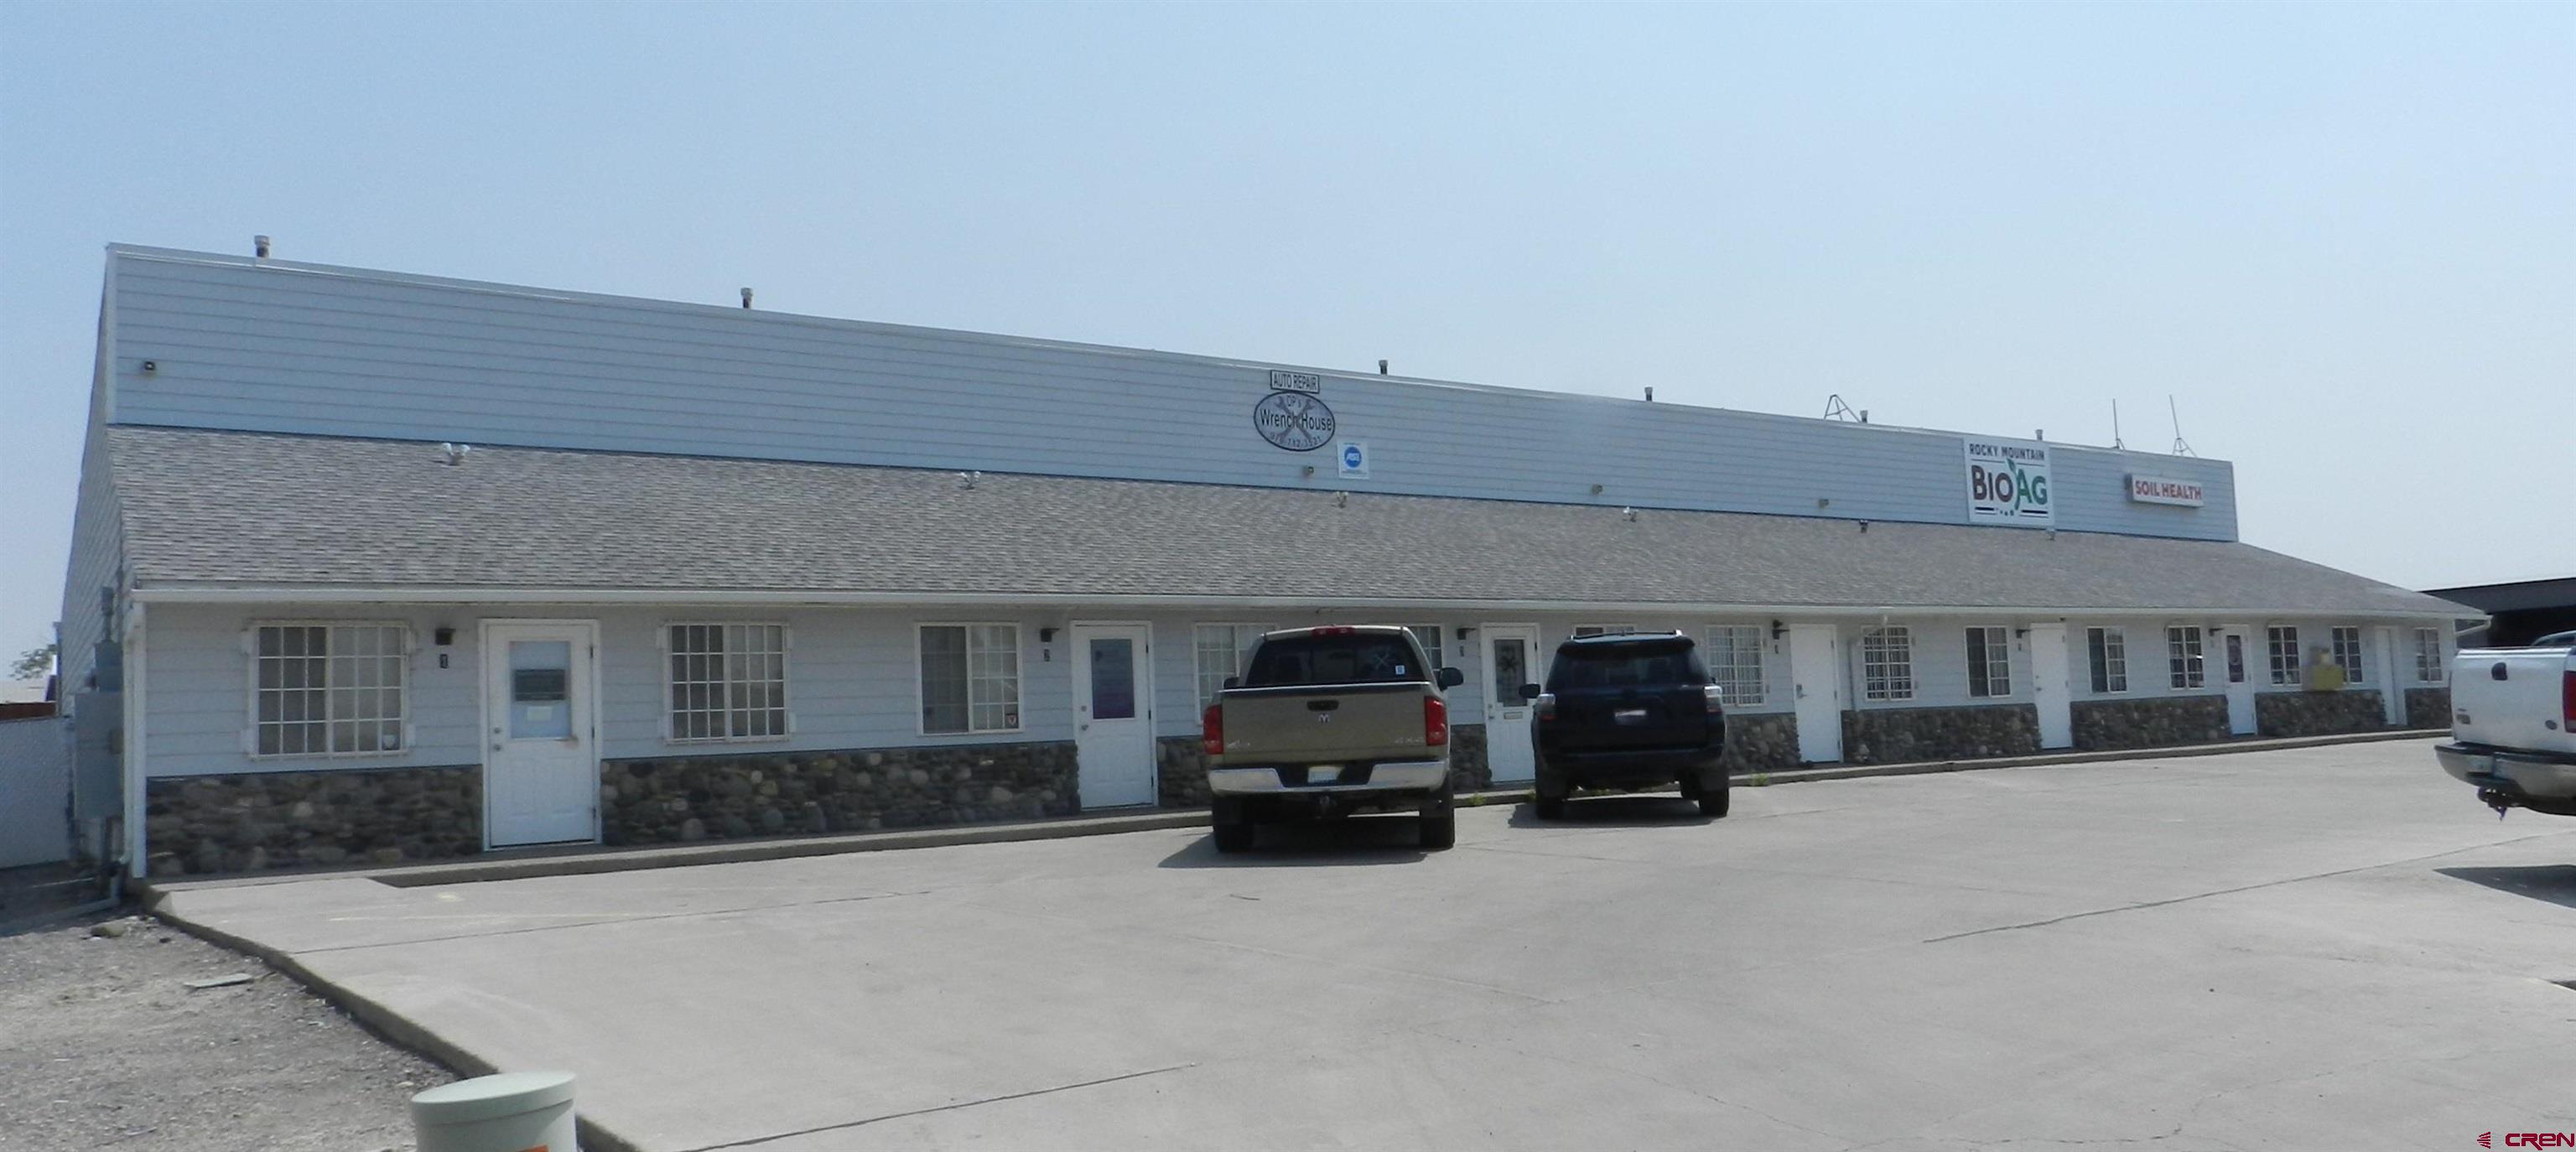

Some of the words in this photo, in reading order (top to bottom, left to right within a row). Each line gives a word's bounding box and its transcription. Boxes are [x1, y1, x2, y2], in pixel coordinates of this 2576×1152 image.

[1274, 373, 1292, 387] AUTO
[1294, 375, 1317, 390] REPAIR
[1260, 408, 1298, 428] Wrench
[1301, 413, 1332, 431] House
[1970, 444, 1998, 456] ROCKY
[2001, 446, 2044, 460] MOUNTAIN
[2135, 480, 2159, 496] SOIL
[2162, 483, 2201, 500] HEALTH
